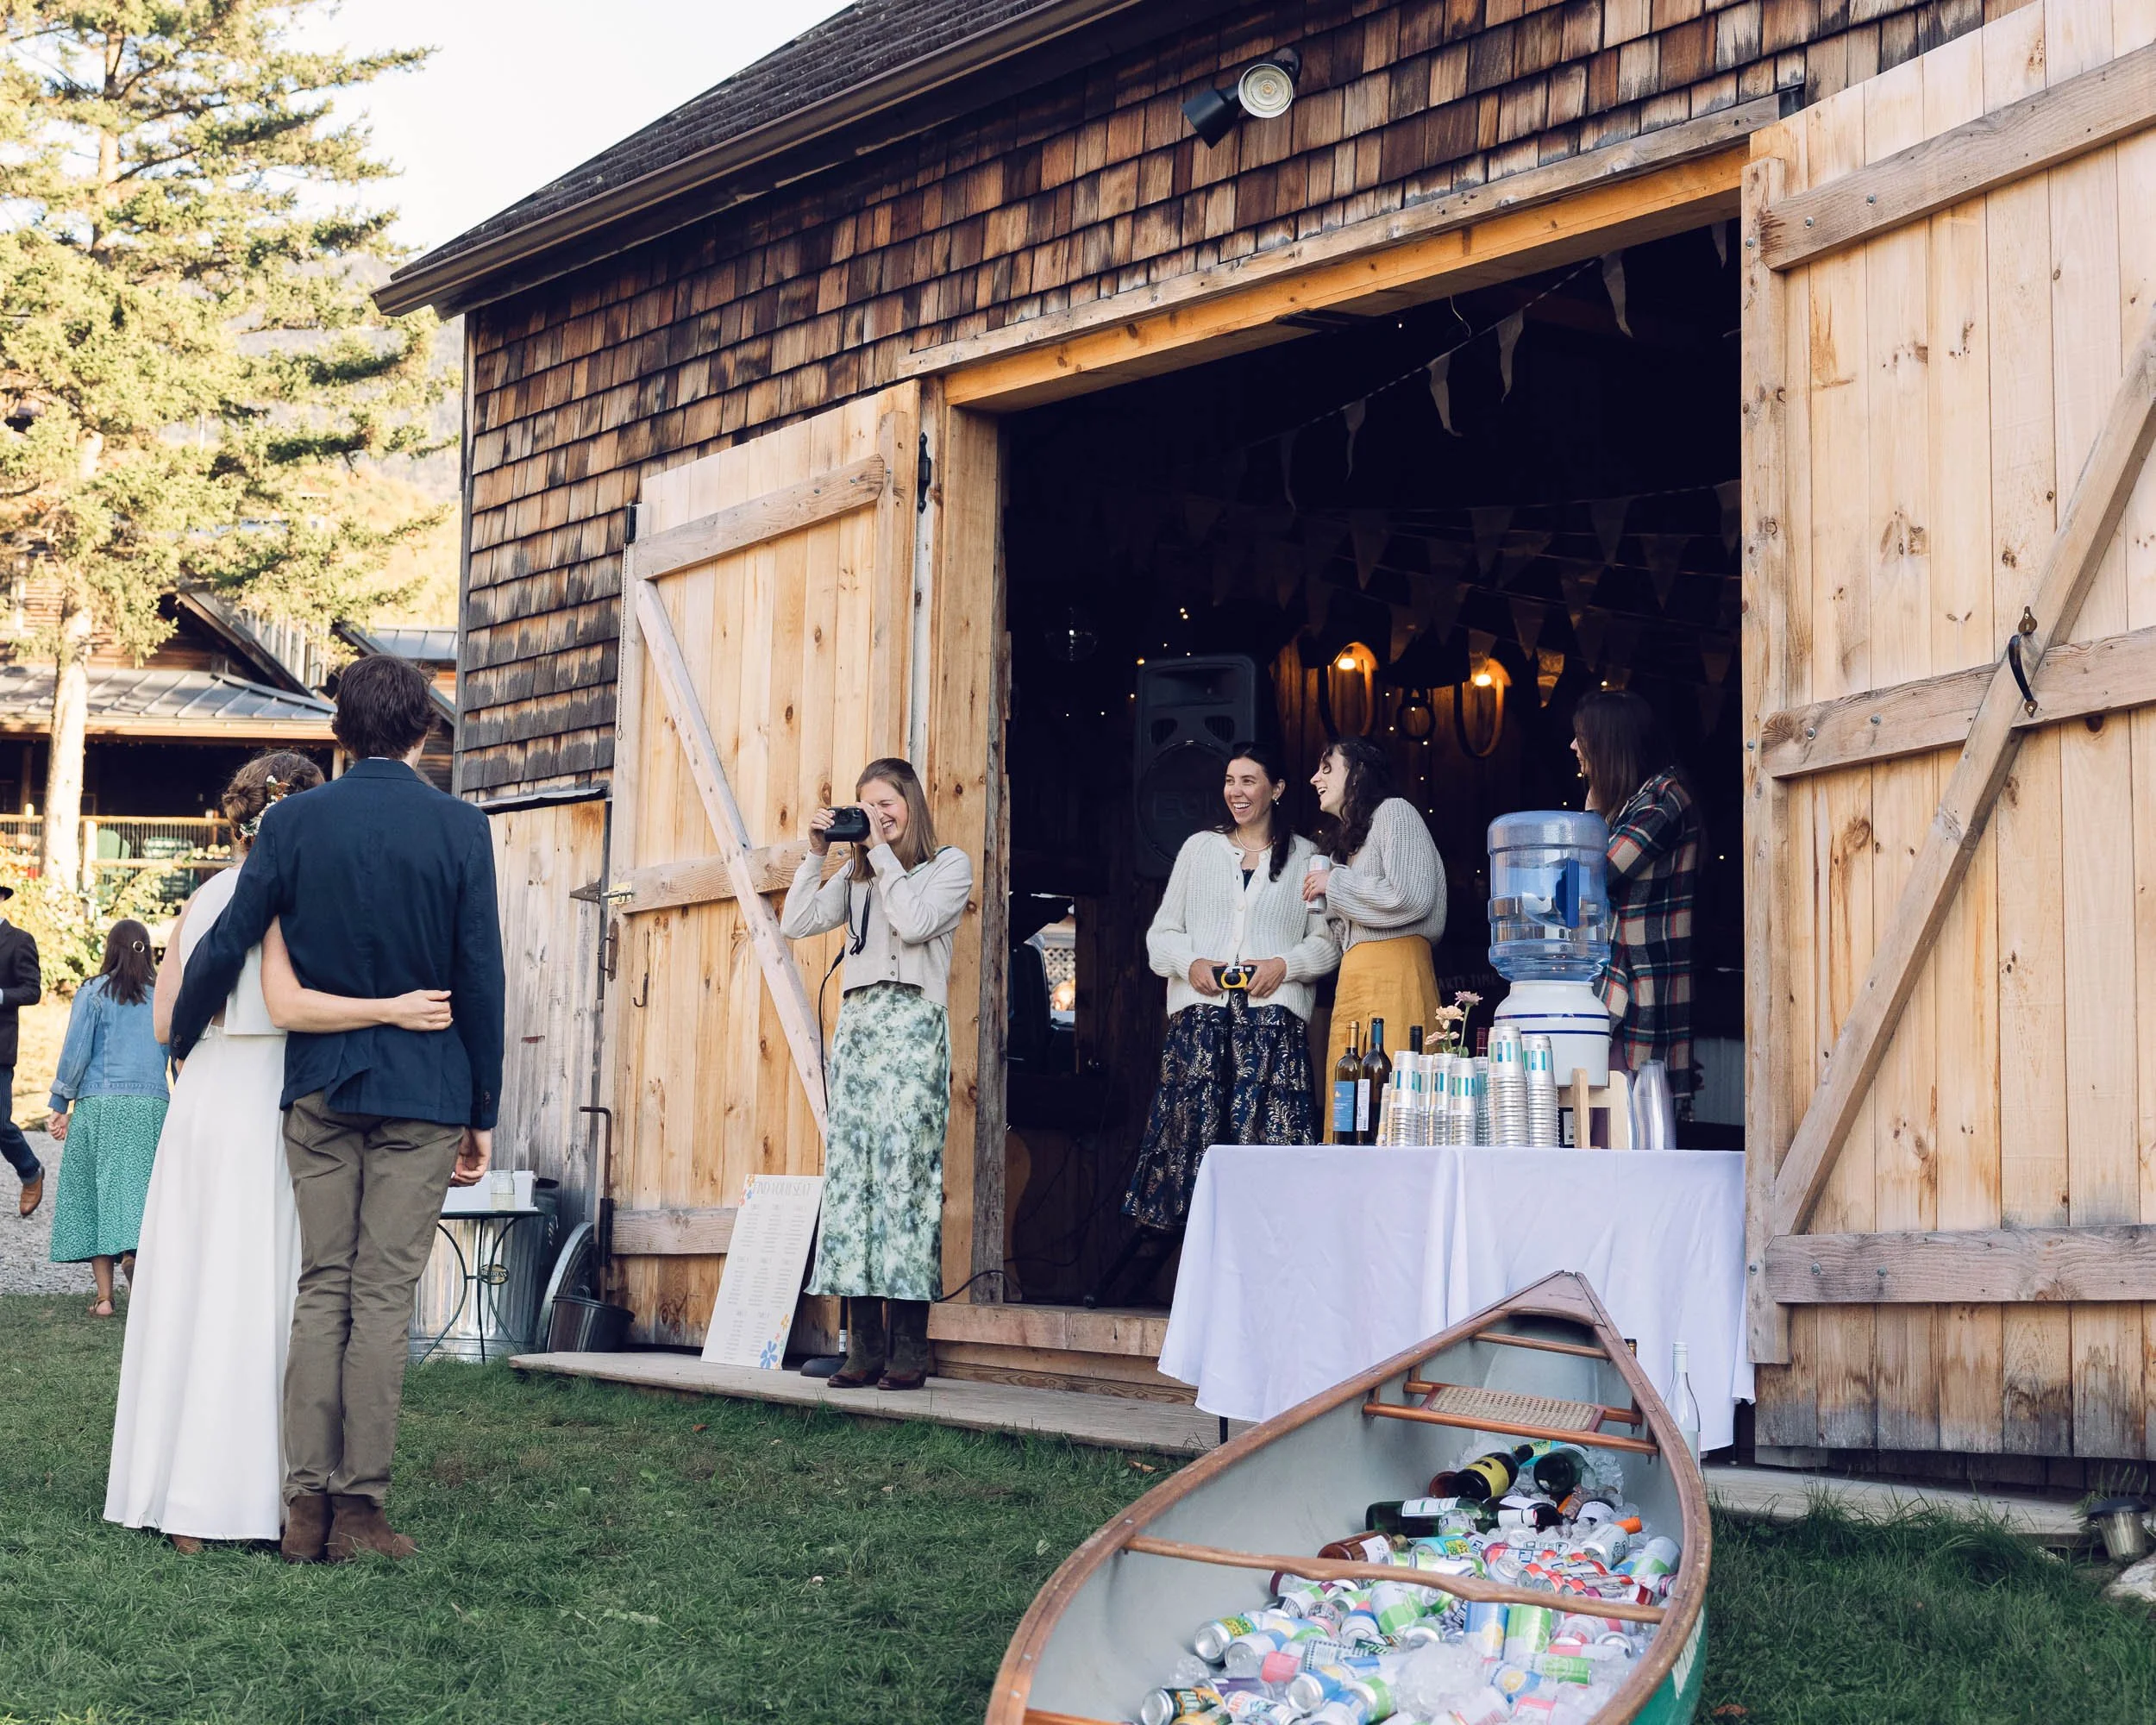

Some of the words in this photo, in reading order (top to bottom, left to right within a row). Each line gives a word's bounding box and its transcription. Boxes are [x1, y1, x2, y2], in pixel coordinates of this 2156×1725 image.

[1438, 975, 1466, 991] ARTY
[752, 1180, 771, 1195] FIND
[771, 1180, 792, 1195] YOUR
[793, 1181, 814, 1196] SEAT
